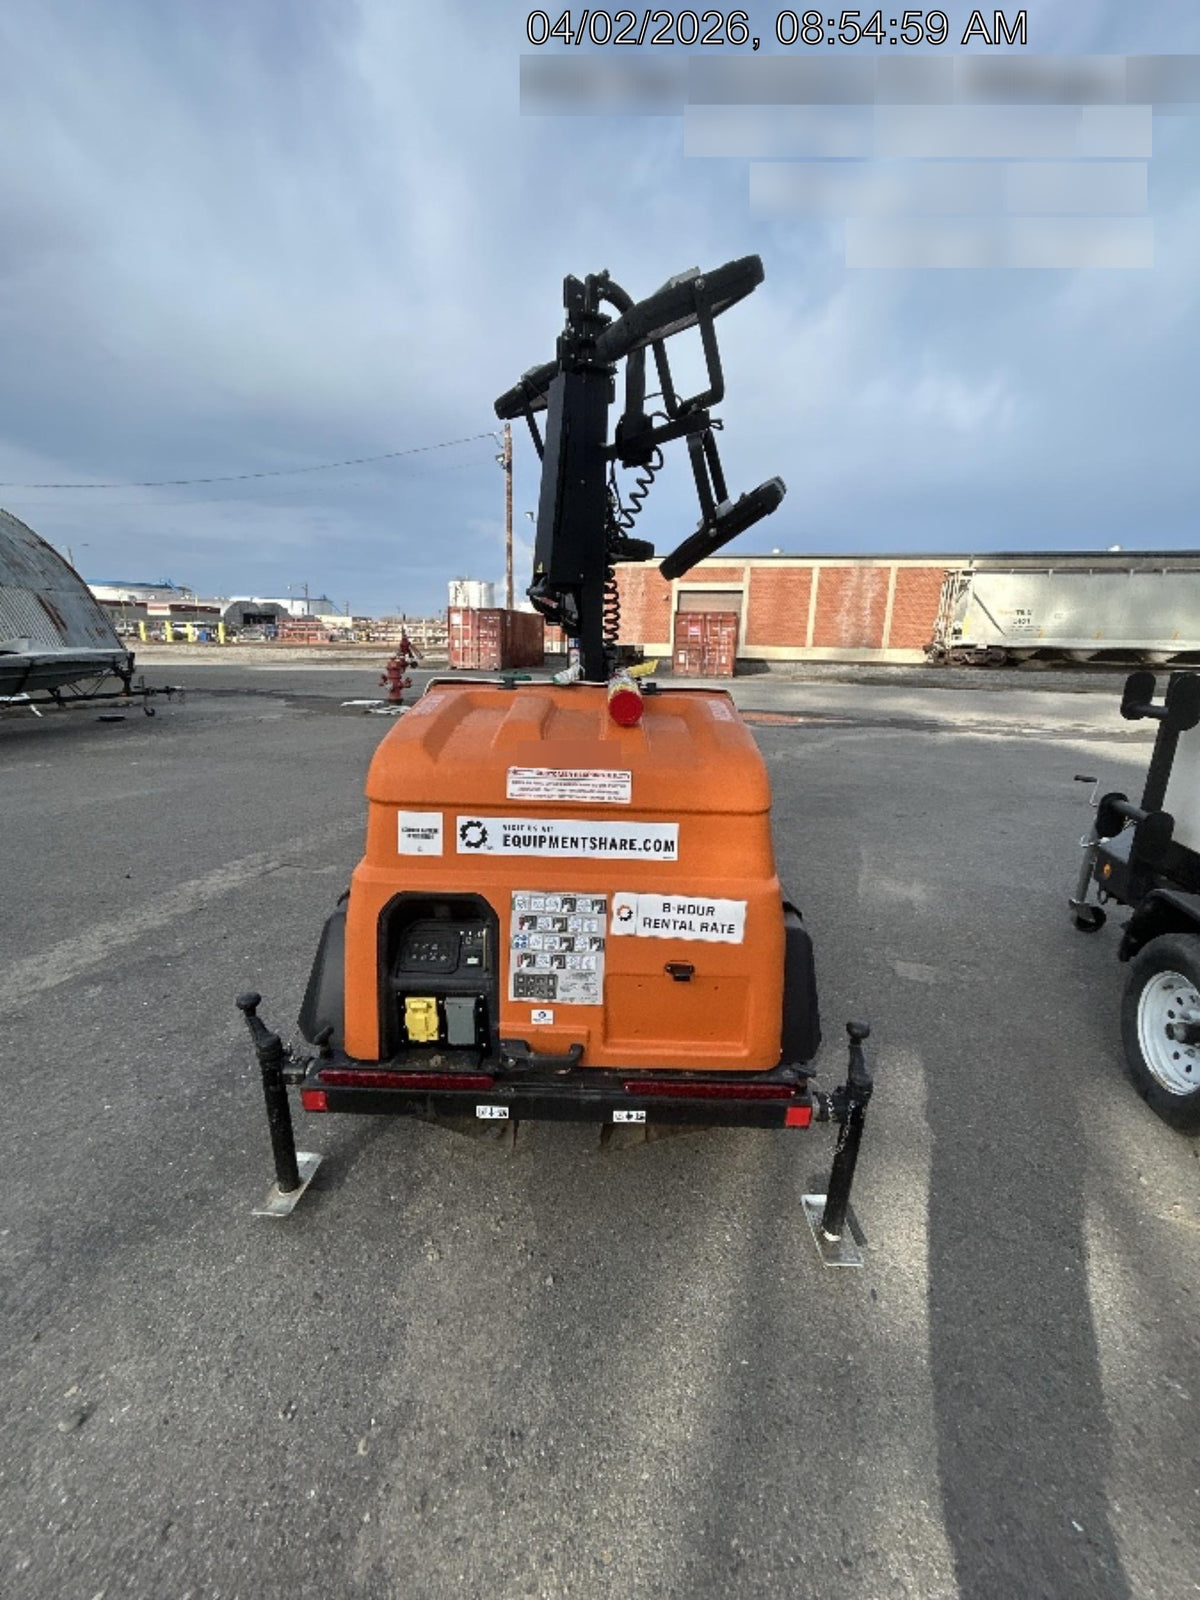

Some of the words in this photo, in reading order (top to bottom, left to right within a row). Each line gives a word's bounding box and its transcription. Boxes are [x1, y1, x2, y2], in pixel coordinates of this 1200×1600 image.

[502, 833, 675, 852] EQUIPMENTSHARE.COM
[642, 917, 696, 932] RENTAL
[699, 921, 736, 934] RATE
